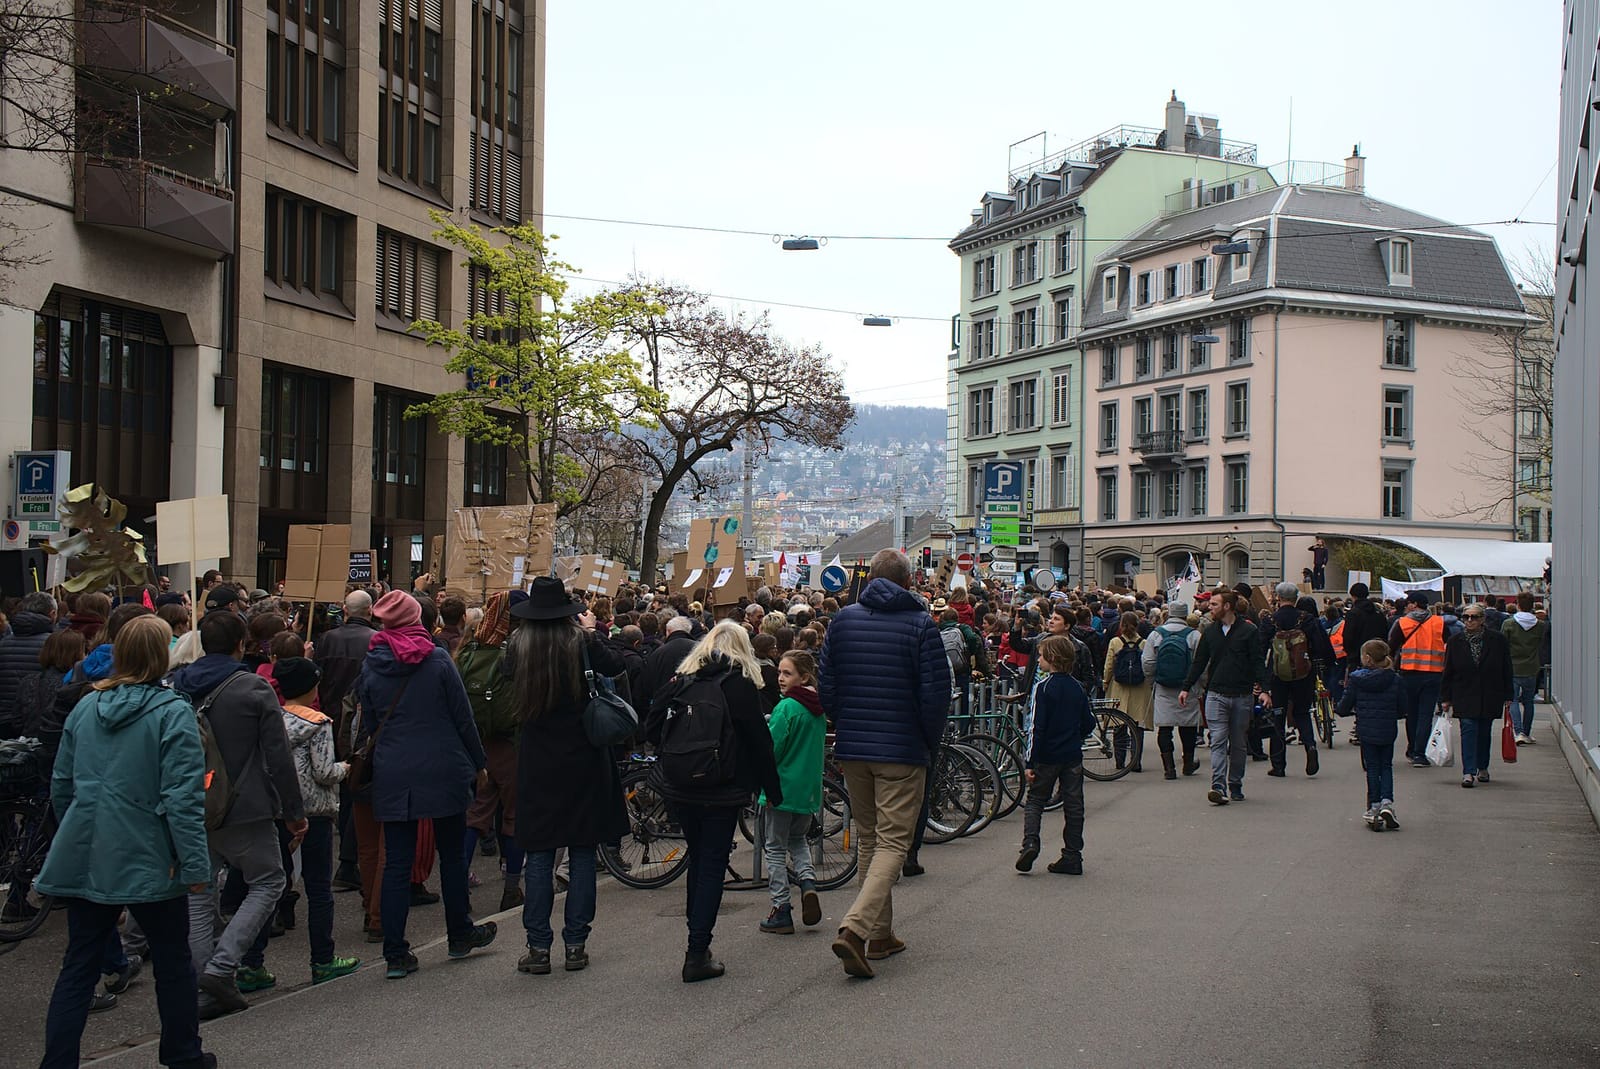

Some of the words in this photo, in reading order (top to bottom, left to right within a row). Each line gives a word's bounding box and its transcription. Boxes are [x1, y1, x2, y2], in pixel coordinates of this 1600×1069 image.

[32, 467, 42, 487] P
[998, 470, 1012, 494] P
[30, 504, 44, 512] Frei
[37, 522, 52, 530] Frei
